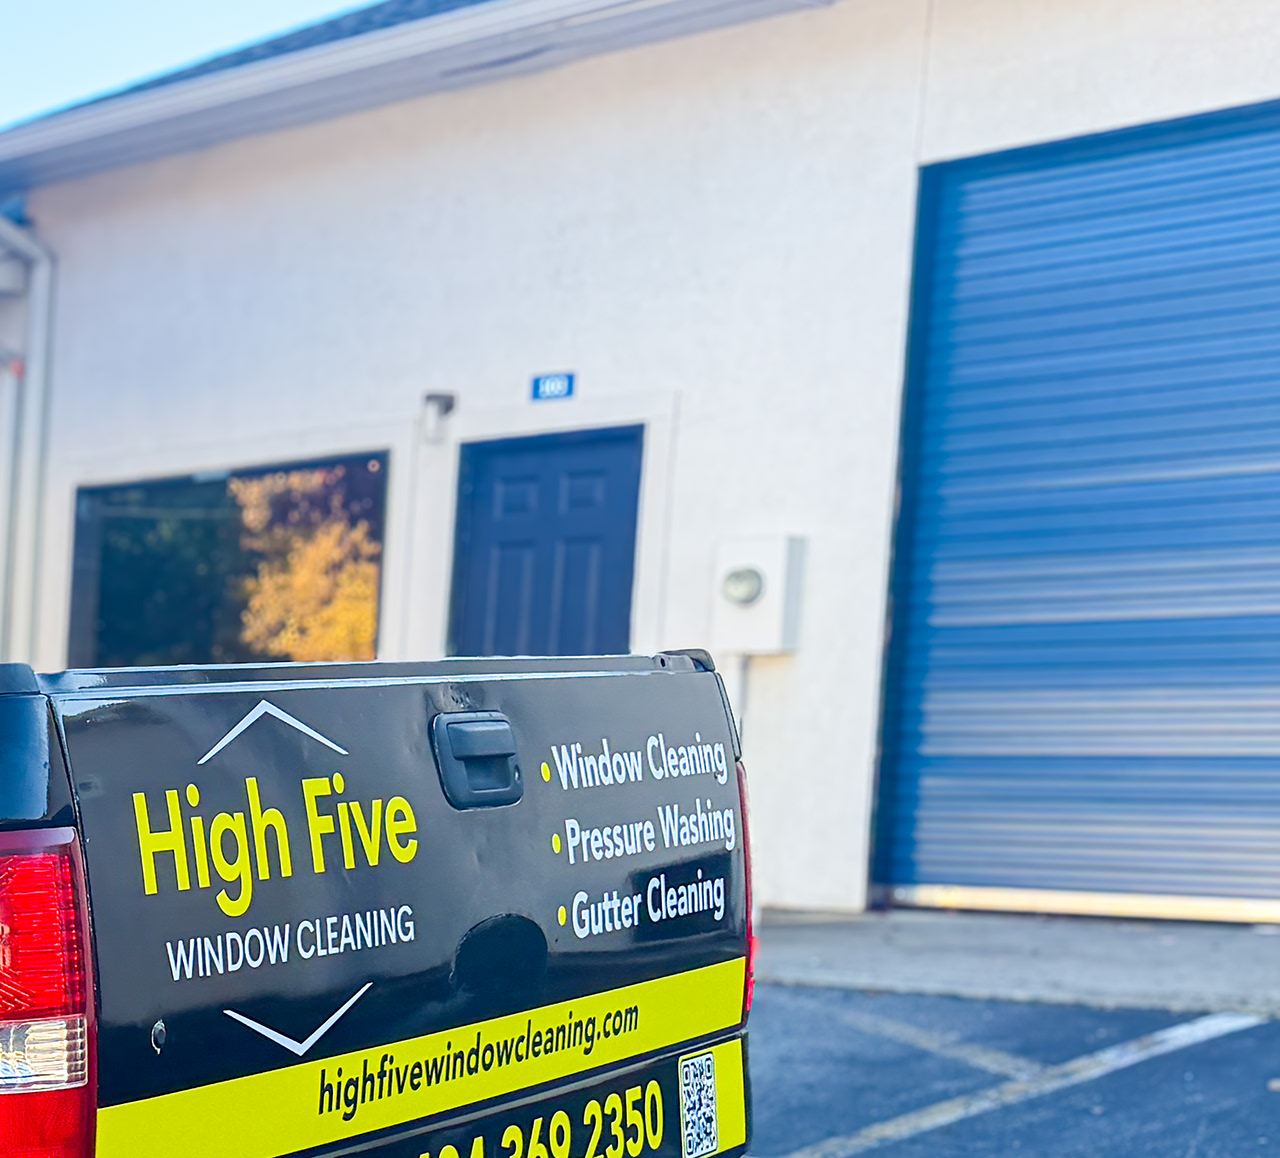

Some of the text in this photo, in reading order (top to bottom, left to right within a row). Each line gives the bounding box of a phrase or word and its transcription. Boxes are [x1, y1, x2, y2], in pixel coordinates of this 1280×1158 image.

[551, 731, 729, 791] Window Cleaning
[133, 772, 419, 917] High Five
[564, 799, 735, 865] Pressure Washing
[571, 870, 725, 939] Gutter Cleaning
[166, 904, 416, 983] WINDOW CLEANING
[317, 1000, 640, 1121] highfivewindowcleaning.com
